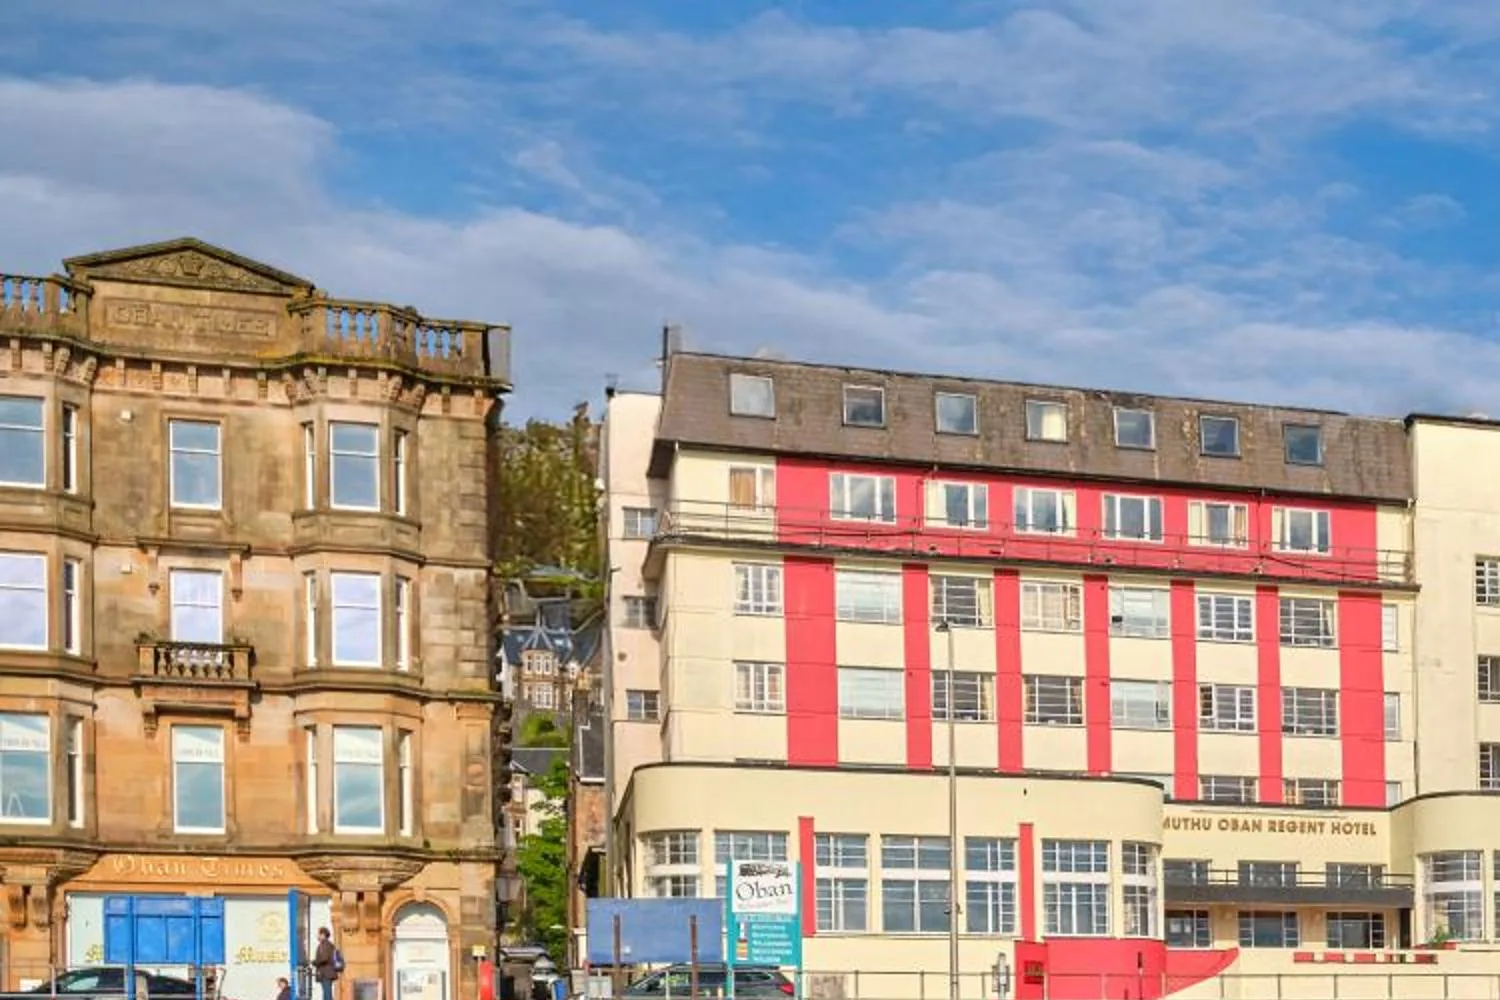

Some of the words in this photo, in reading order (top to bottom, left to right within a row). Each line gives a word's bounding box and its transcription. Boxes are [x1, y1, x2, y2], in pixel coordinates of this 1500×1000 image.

[1217, 819, 1262, 833] OBAN
[1267, 820, 1326, 834] REGENT
[1331, 822, 1377, 836] HOTEL
[113, 854, 187, 876] Oban
[198, 857, 286, 878] Times
[735, 881, 792, 901] Oban
